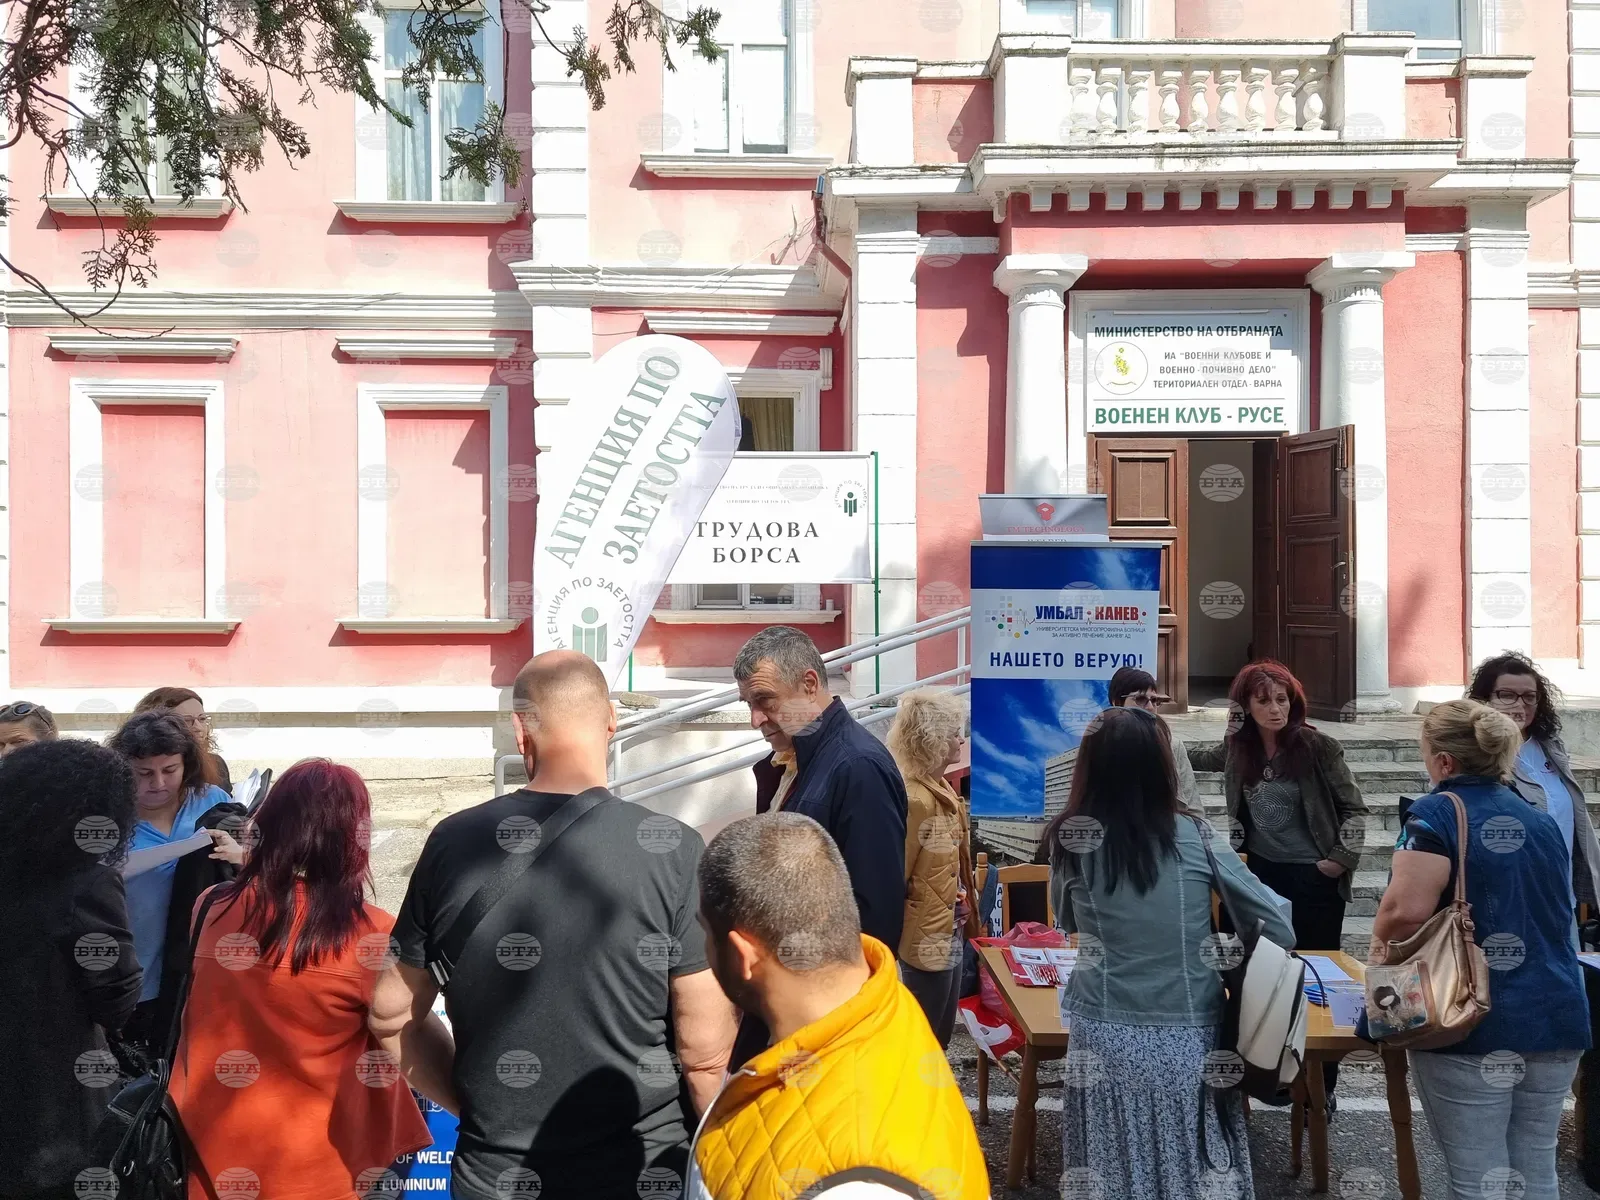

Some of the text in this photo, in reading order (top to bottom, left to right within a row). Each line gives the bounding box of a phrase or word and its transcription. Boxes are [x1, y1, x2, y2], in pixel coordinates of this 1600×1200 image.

[1094, 325, 1283, 338] МИНИСТЕРСТВО НА ОТБРАНАТА
[1164, 351, 1176, 360] ИА
[1223, 351, 1262, 360] КЛУБОВЕ
[1265, 351, 1271, 359] И
[1159, 366, 1195, 374] ВОЕННО
[1202, 365, 1245, 374] ПОЧИВНО
[1153, 379, 1218, 388] ТЕРИТОРИАЛЕН
[1221, 380, 1248, 389] ОТДЕЛ
[1254, 380, 1282, 388] ВАРНА
[1095, 408, 1169, 424] ВОЕНЕН
[1176, 407, 1222, 424] КЛУБ
[1238, 406, 1284, 423] РУСЕ
[544, 405, 652, 569] АГЕНЦИЯ
[627, 356, 680, 407] ПО
[602, 392, 727, 564] ЗАЕТОСТТА
[697, 522, 819, 541] ТРУДОВА
[712, 547, 800, 563] БОРСА
[572, 577, 592, 590] ПО
[596, 578, 634, 648] ЗАЕТОСТТА
[1035, 606, 1138, 620] УМБАЛ КАНЕВ
[990, 652, 1143, 668] НАШЕТО ВЕРУЮ!
